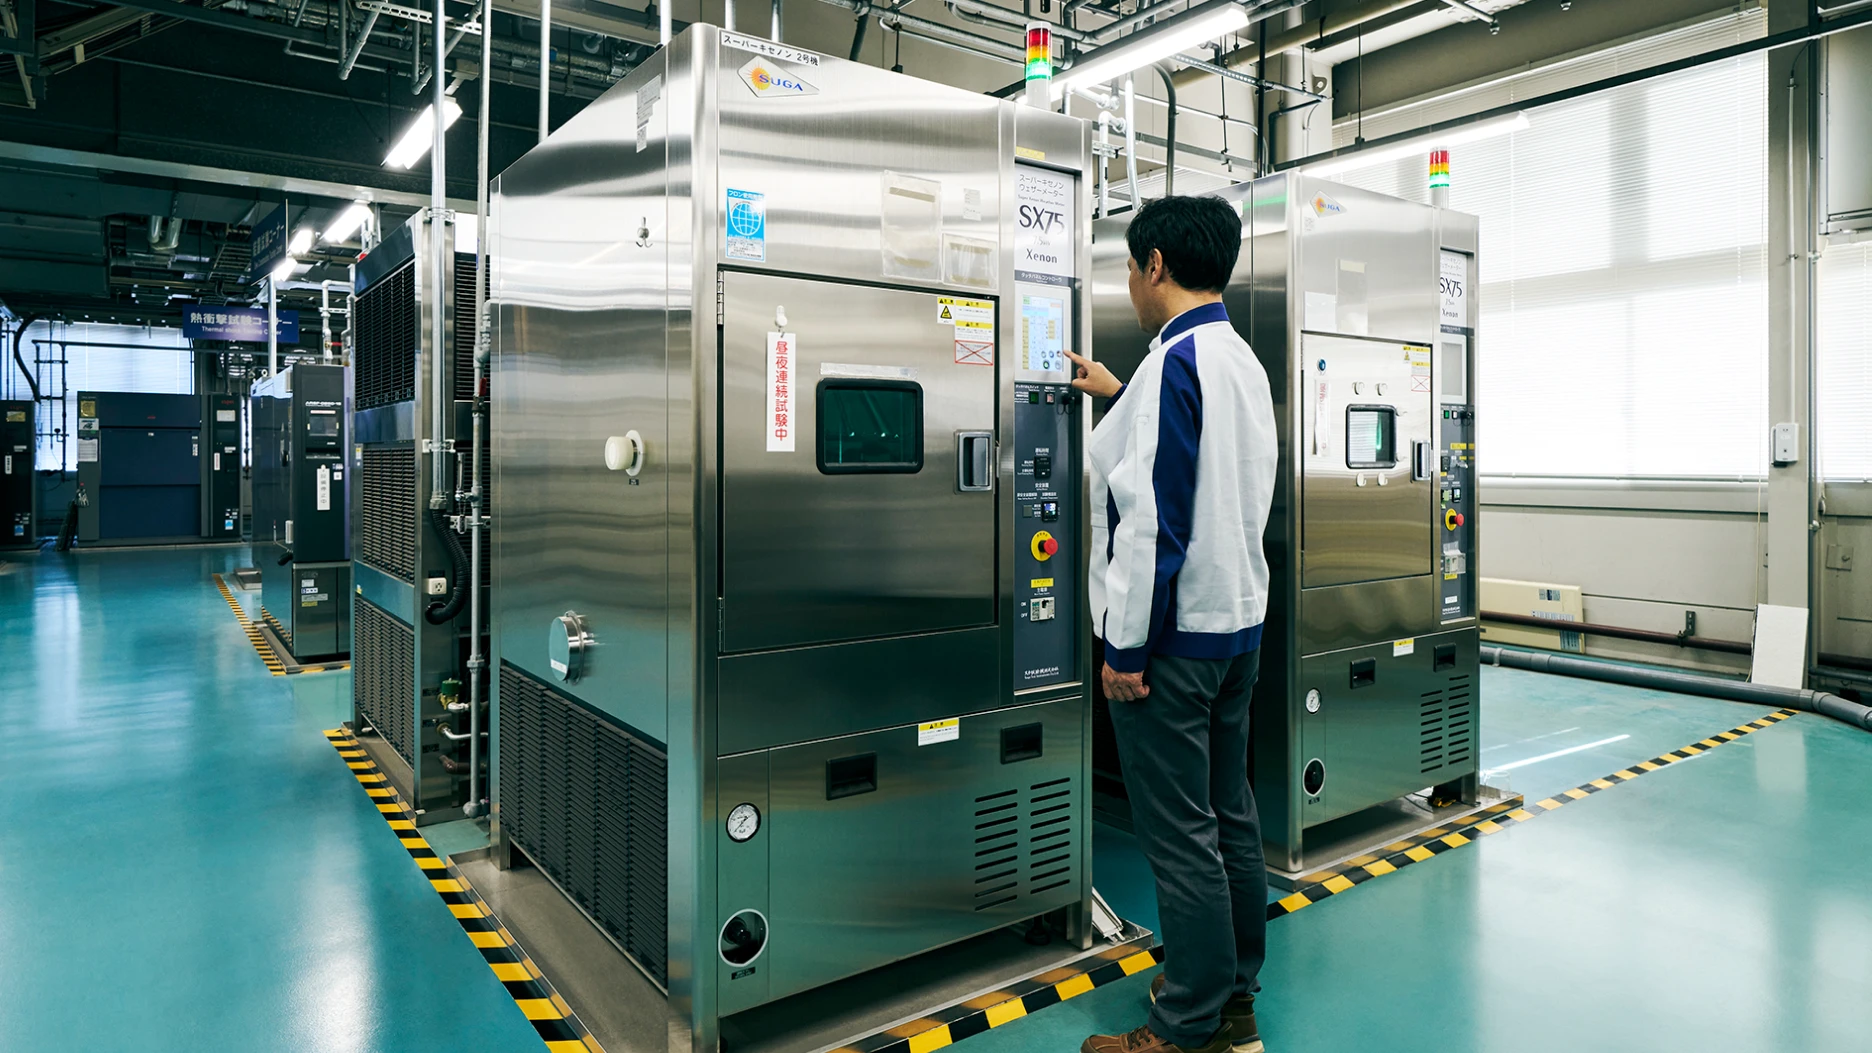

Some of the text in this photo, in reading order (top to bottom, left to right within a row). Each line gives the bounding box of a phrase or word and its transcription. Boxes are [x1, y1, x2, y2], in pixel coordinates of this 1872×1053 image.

[724, 35, 819, 66] スーパーキセノン 2号機
[759, 74, 804, 91] SUGA
[1019, 174, 1064, 189] スーパーキセノン
[1019, 184, 1064, 197] ウェザーメーター
[1019, 204, 1065, 235] SX75
[1026, 248, 1058, 264] Xenon
[1440, 276, 1463, 298] SX75
[775, 341, 788, 442] 昼夜連続試験中
